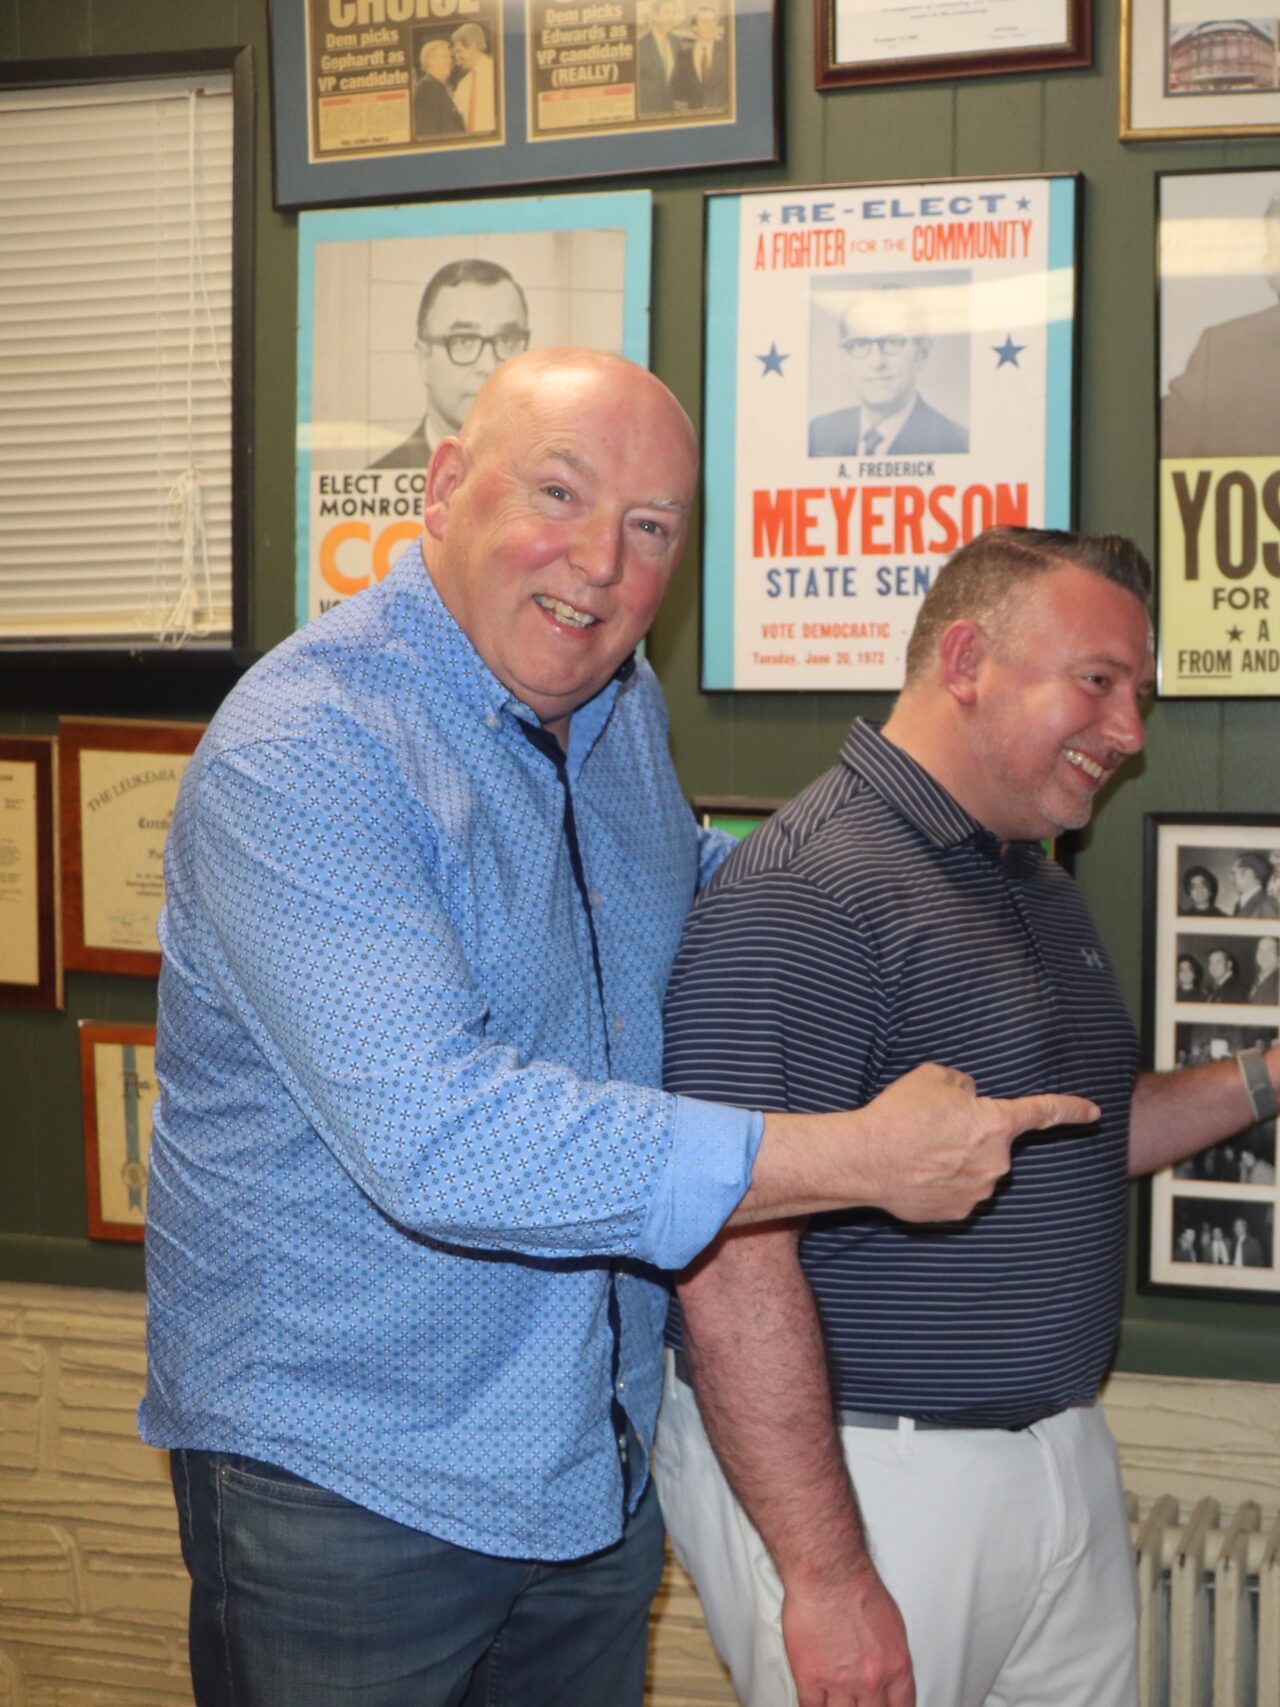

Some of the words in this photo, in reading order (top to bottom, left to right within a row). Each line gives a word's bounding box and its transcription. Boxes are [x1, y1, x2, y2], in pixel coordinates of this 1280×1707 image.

[546, 8, 579, 24] Dem
[582, 4, 622, 23] picks
[326, 32, 357, 48] Dem
[361, 28, 399, 47] picks
[542, 25, 605, 44] Edwards
[609, 25, 627, 38] as
[321, 50, 385, 71] Gephardt
[388, 50, 405, 64] as
[537, 49, 556, 65] VP
[560, 43, 633, 63] candidate
[318, 76, 337, 92] VP
[340, 70, 409, 90] candidate
[551, 63, 619, 88] (REALLY)
[781, 194, 1006, 224] RE-ELECT
[755, 233, 766, 271] A
[772, 228, 846, 269] FIGHTER
[850, 239, 877, 253] FOR
[883, 238, 906, 252] THE
[912, 220, 1033, 262] COMMUNITY
[838, 463, 850, 478] A.
[859, 462, 935, 477] FREDERICK
[319, 474, 382, 494] ELECT
[320, 498, 423, 516] MONROE
[753, 483, 1028, 558] MEYERSON
[766, 567, 857, 598] STATE
[1212, 587, 1270, 610] FOR
[761, 622, 795, 639] VOTE
[802, 622, 891, 639] DEMOCRATIC
[1257, 619, 1270, 642] A
[805, 651, 830, 665] June
[858, 651, 885, 665] 1972
[1177, 650, 1232, 673] FROM
[1241, 649, 1280, 673] AND
[87, 789, 112, 813] THE
[113, 768, 176, 797] LEUKEMIA
